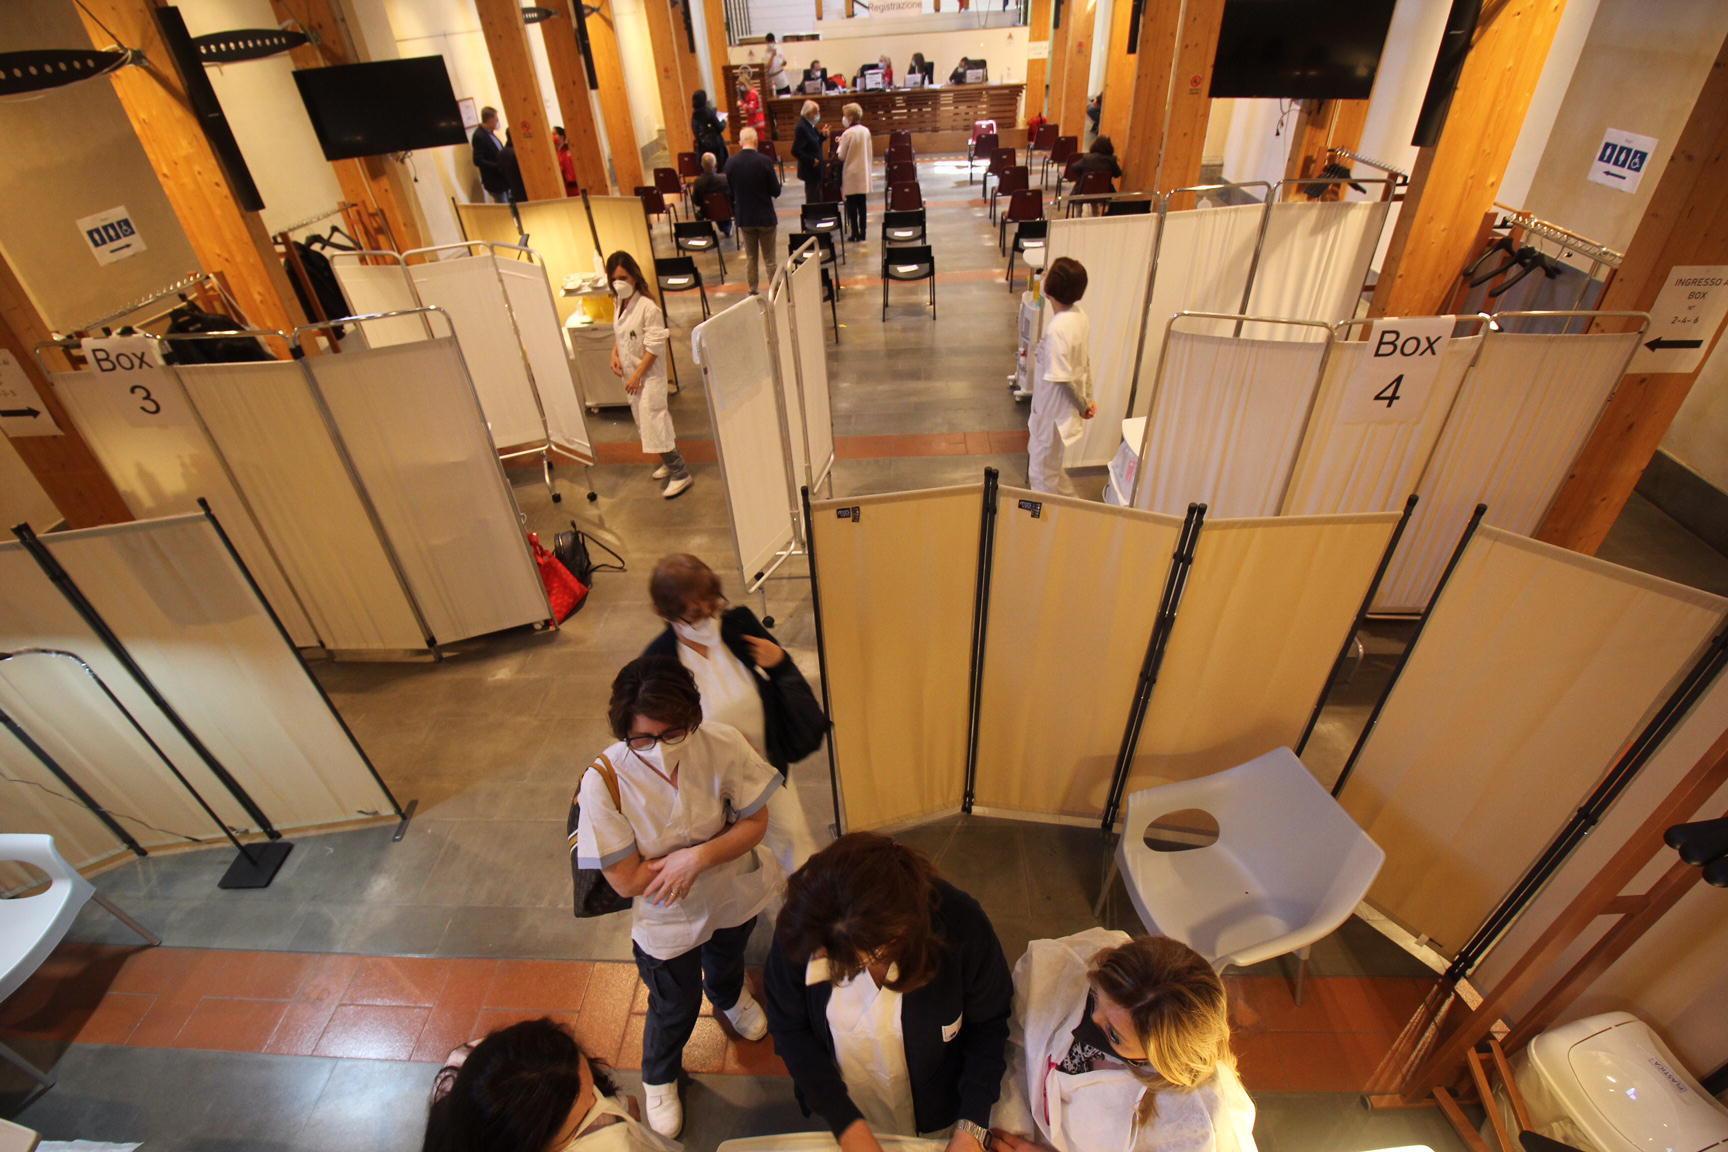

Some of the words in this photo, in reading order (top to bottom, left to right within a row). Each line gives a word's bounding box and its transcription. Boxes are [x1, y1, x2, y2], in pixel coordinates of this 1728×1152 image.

[868, 2, 922, 13] Registrazione
[1674, 278, 1722, 287] INGRESSO
[1687, 291, 1709, 300] BOX
[1373, 330, 1442, 357] Box
[91, 348, 154, 372] Box
[129, 384, 161, 414] 3
[1373, 374, 1404, 408] 4
